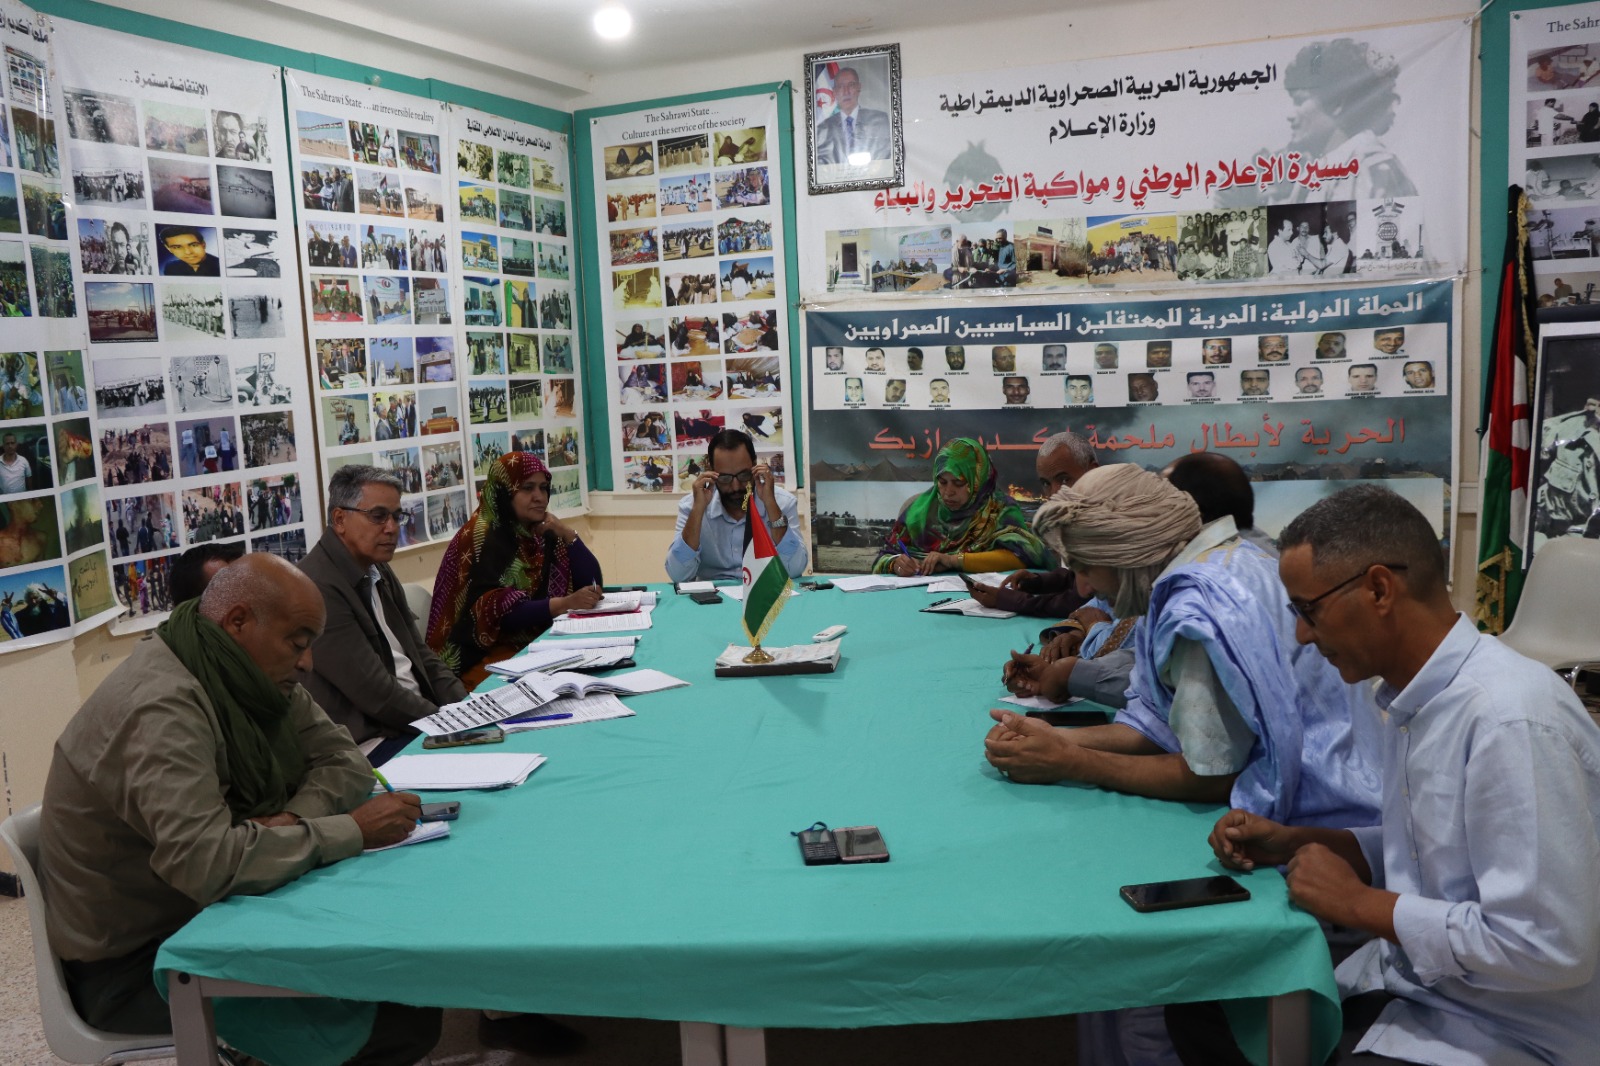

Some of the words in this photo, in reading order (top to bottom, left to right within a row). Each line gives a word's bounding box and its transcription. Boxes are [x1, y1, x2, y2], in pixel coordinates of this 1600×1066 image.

[1546, 20, 1572, 33] The
[1038, 78, 1124, 109] الصحراوية
[1126, 72, 1187, 101] العربية
[1188, 63, 1278, 96] الجمهورية
[301, 85, 316, 98] The
[315, 89, 344, 105] Sahrawi
[345, 95, 362, 109] State
[379, 102, 414, 119] irreversible
[414, 111, 435, 125] reality
[644, 113, 660, 123] The
[660, 109, 691, 121] Sahrawi
[691, 108, 710, 117] State
[939, 86, 1038, 118] الديمقراطية
[621, 129, 650, 140] Culture
[658, 126, 671, 135] the
[671, 122, 697, 134] service
[697, 120, 707, 130] of
[706, 118, 719, 128] the
[719, 116, 747, 128] society
[1118, 111, 1156, 137] وزارة
[1130, 161, 1200, 208] الوطني
[1204, 155, 1284, 196] الإعلام
[1286, 152, 1360, 190] مسيرة
[938, 174, 1019, 212] التحرير
[1022, 170, 1110, 206] مواكبة
[1188, 304, 1257, 330] الحرية
[1357, 291, 1423, 316] الحملة
[844, 315, 950, 341] الصحراويين
[955, 312, 1071, 339] السياسيين
[1076, 307, 1182, 335] للمعتقلين
[1086, 424, 1175, 451] ملحمة
[1190, 413, 1285, 457] لأبطال
[1300, 417, 1406, 455] الحرية
